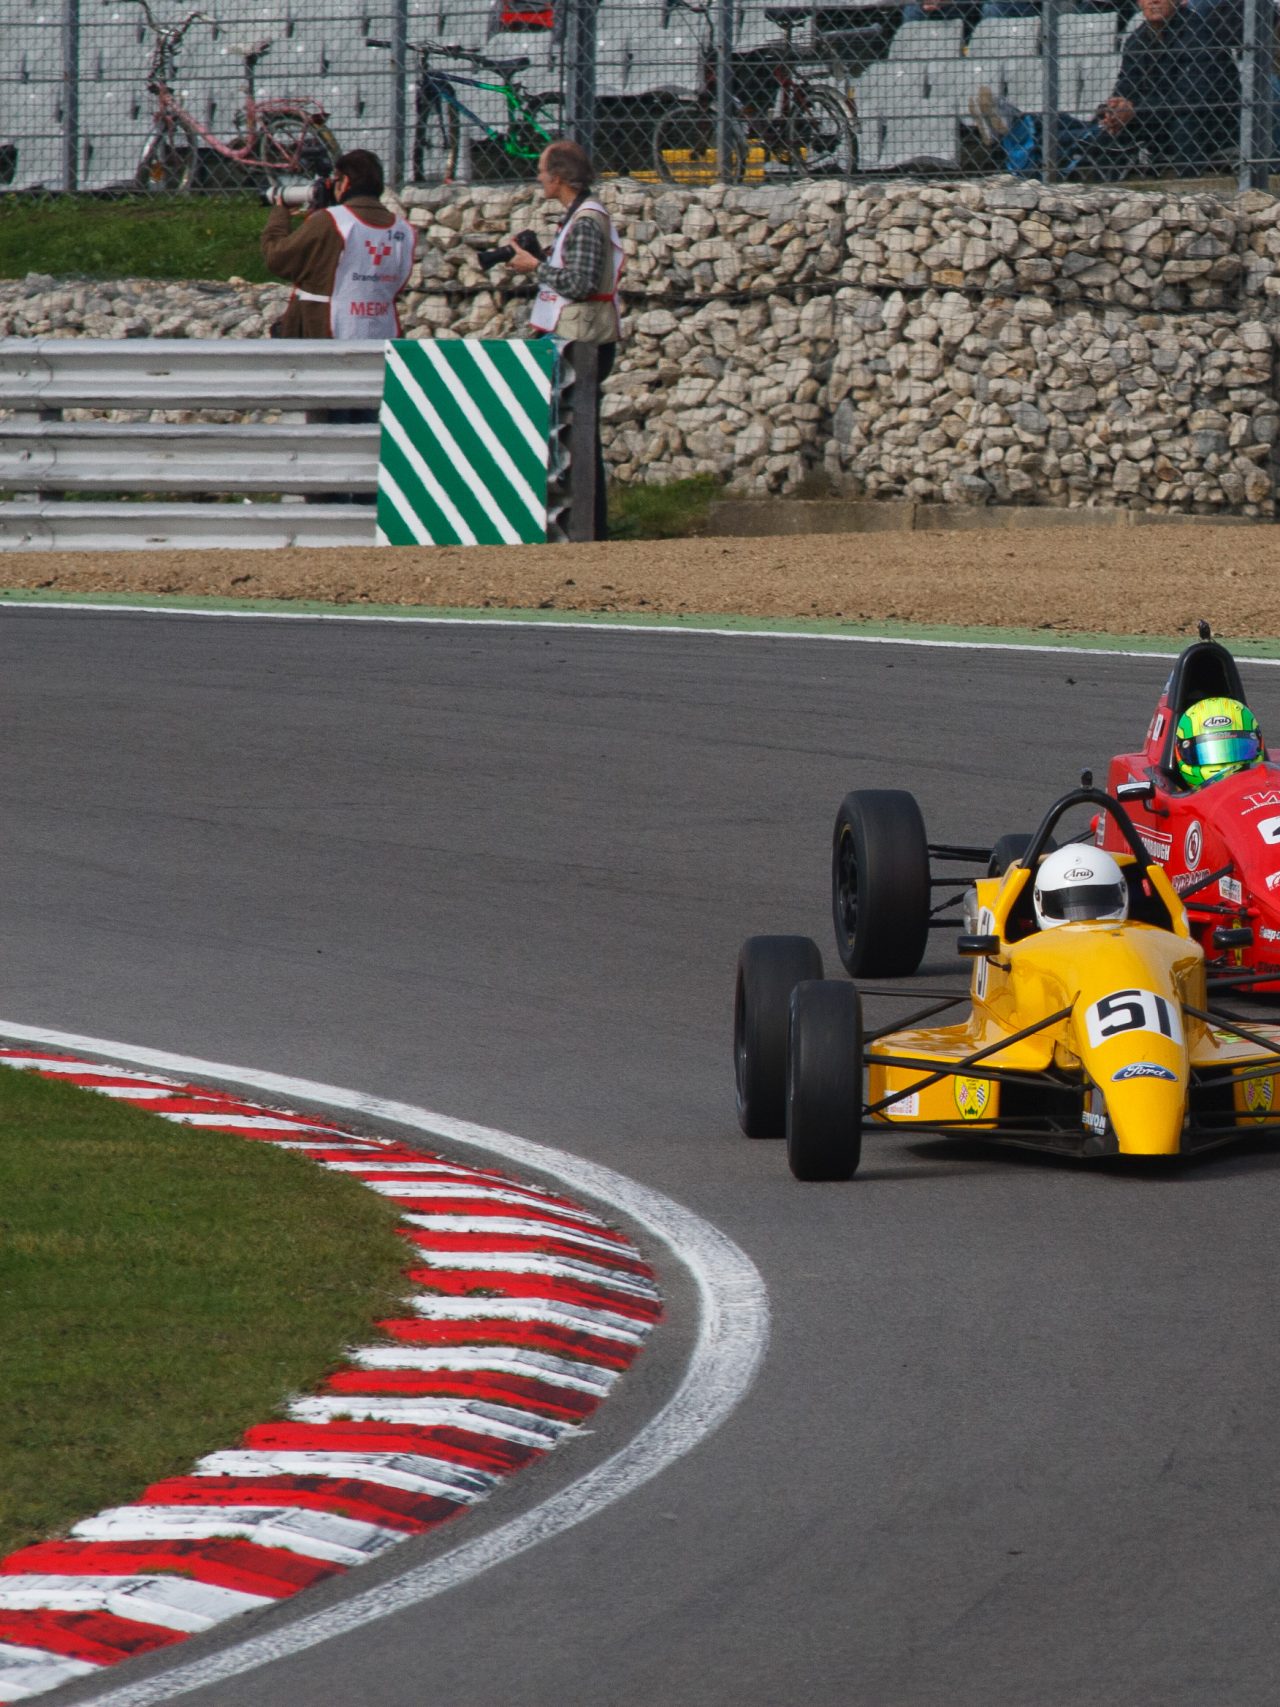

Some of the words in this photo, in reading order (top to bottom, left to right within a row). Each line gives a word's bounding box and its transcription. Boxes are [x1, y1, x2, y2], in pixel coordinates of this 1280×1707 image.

[1068, 868, 1093, 880] Arai
[1096, 990, 1172, 1037] 51
[1123, 1064, 1167, 1078] Ford
